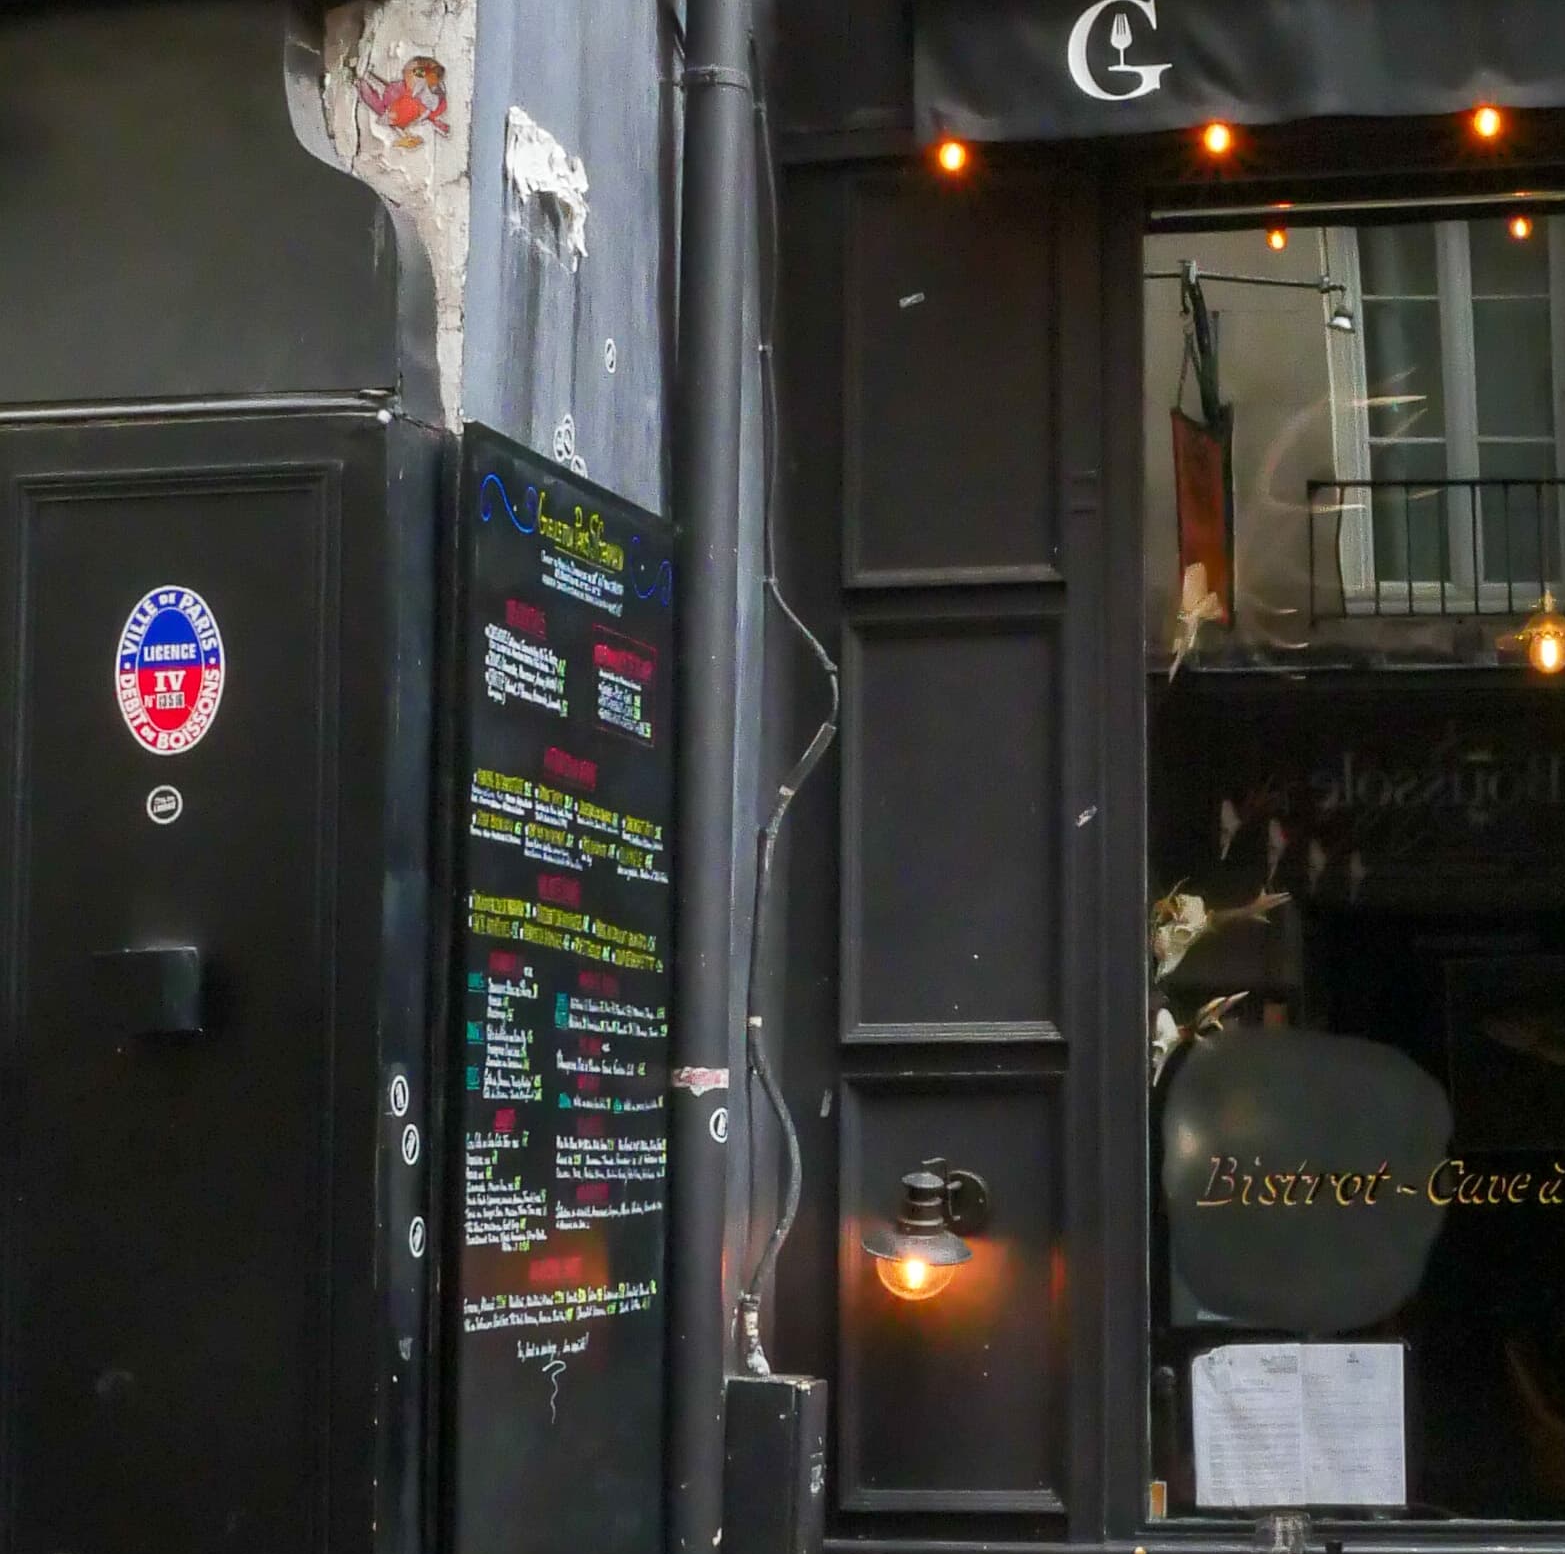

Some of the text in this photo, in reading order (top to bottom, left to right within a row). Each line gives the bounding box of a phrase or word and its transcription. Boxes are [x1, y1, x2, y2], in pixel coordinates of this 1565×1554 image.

[121, 593, 218, 656] VILLE DE PARIS
[144, 643, 196, 661] LICENCE
[155, 670, 186, 692] IV
[120, 673, 149, 727] DEBIT
[157, 668, 220, 748] BOISSONS
[1197, 1156, 1392, 1208] Bistrot
[1426, 1157, 1532, 1208] Cave
